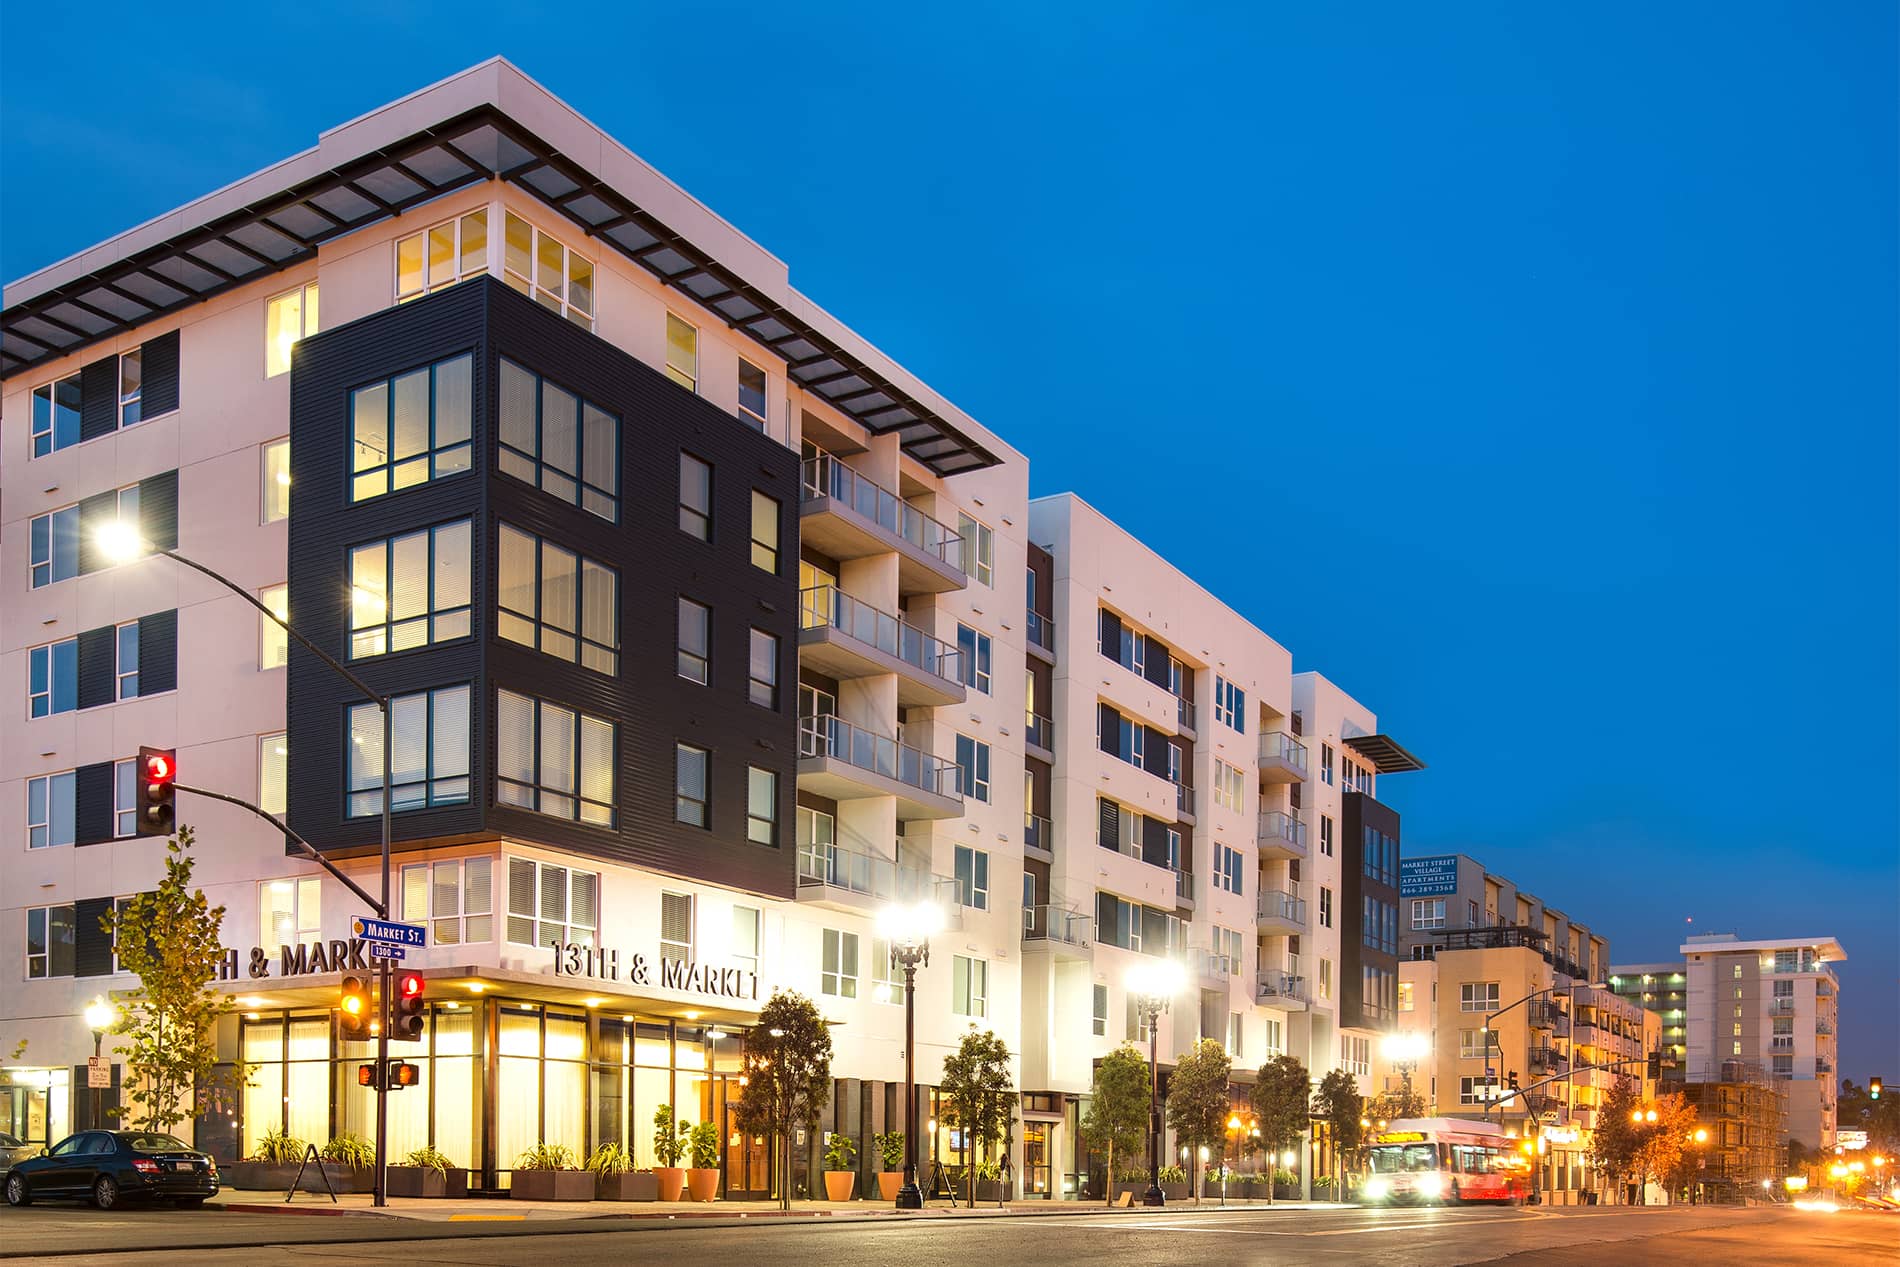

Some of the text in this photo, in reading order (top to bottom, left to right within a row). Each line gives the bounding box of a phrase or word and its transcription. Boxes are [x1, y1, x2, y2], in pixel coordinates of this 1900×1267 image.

[1402, 875, 1455, 884] APARTMENTS
[368, 923, 405, 941] MARKET
[248, 946, 270, 979] &
[281, 938, 399, 977] MARK
[375, 946, 392, 958] 1300
[551, 940, 760, 1001] 13TH & MARKET
